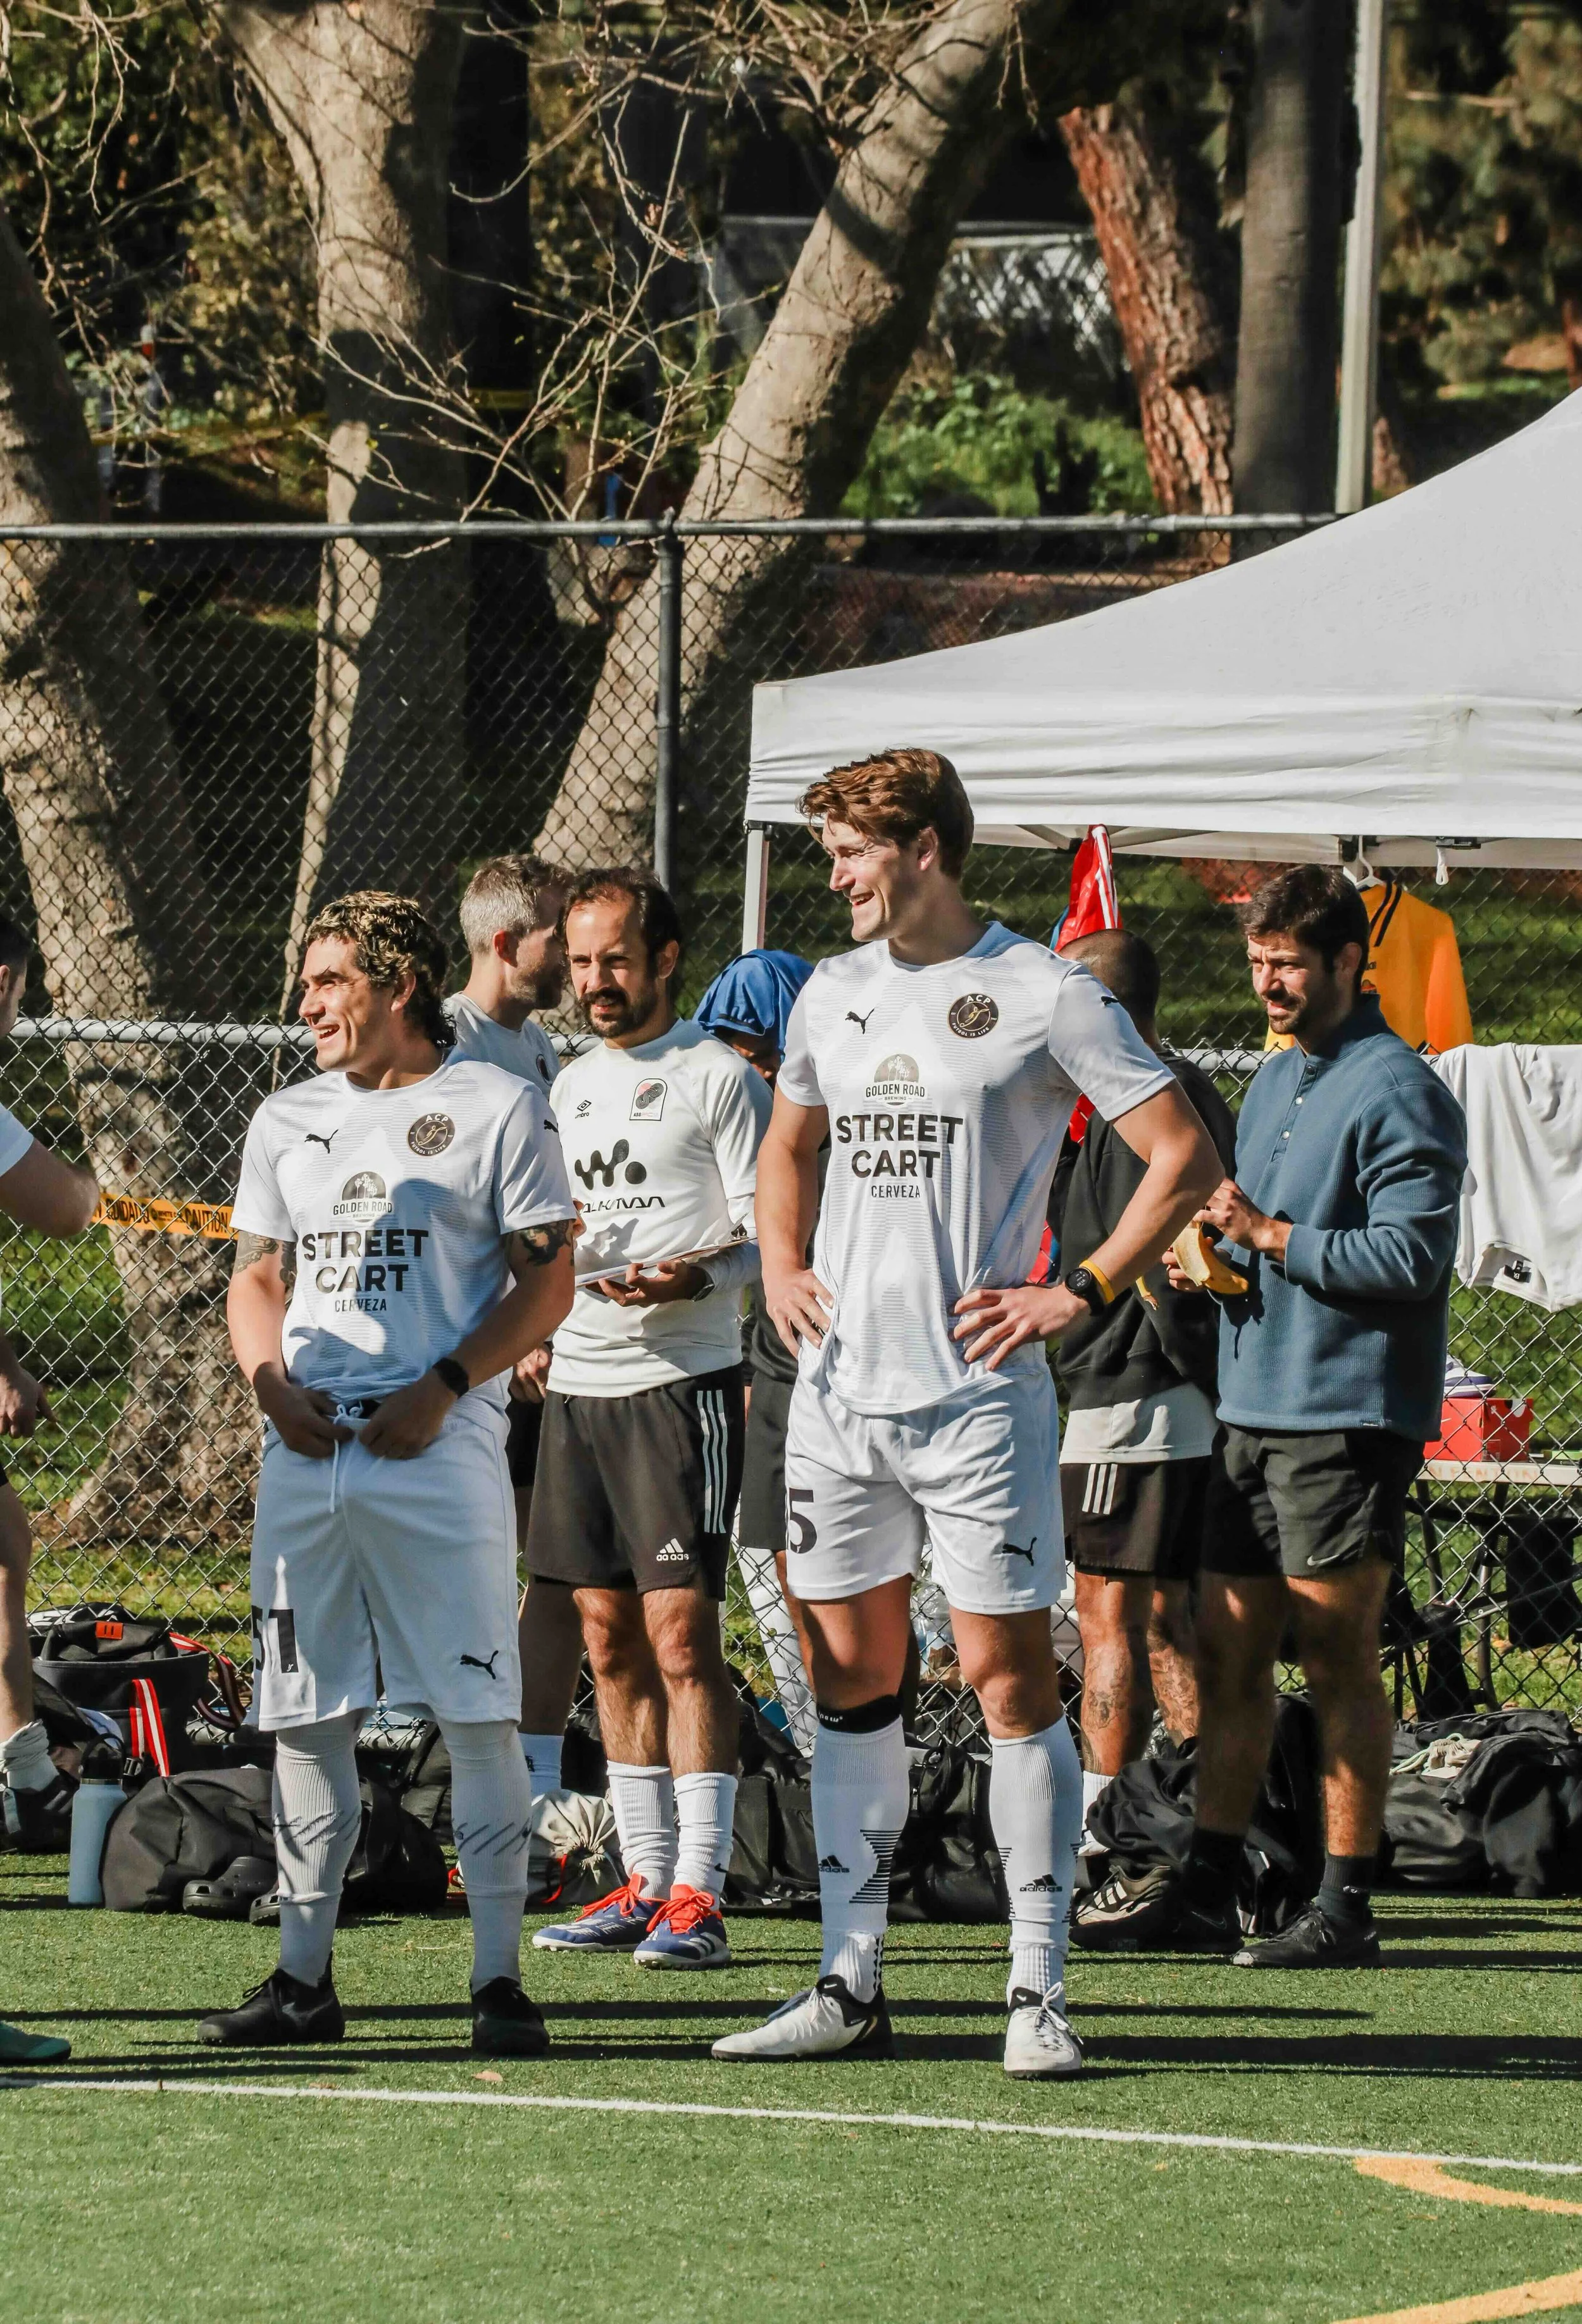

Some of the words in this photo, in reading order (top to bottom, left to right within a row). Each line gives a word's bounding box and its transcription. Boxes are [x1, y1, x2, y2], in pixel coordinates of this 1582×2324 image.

[966, 995, 992, 1004] ACP
[866, 1083, 900, 1098] GOLDEN
[903, 1084, 925, 1097] ROAD
[426, 1114, 449, 1122] ACP
[837, 1114, 964, 1145] STREET
[851, 1150, 941, 1179] CART
[871, 1184, 921, 1199] CERVEZA
[333, 1202, 370, 1215] GOLDEN
[371, 1201, 393, 1214] ROAD
[184, 1208, 228, 1233] CAUTION
[302, 1228, 429, 1261] STREET
[316, 1264, 409, 1294] CART
[334, 1298, 387, 1313] CERVEZA
[788, 1488, 818, 1555] 5
[656, 1553, 690, 1562] addas
[1019, 1884, 1063, 1893] adidas
